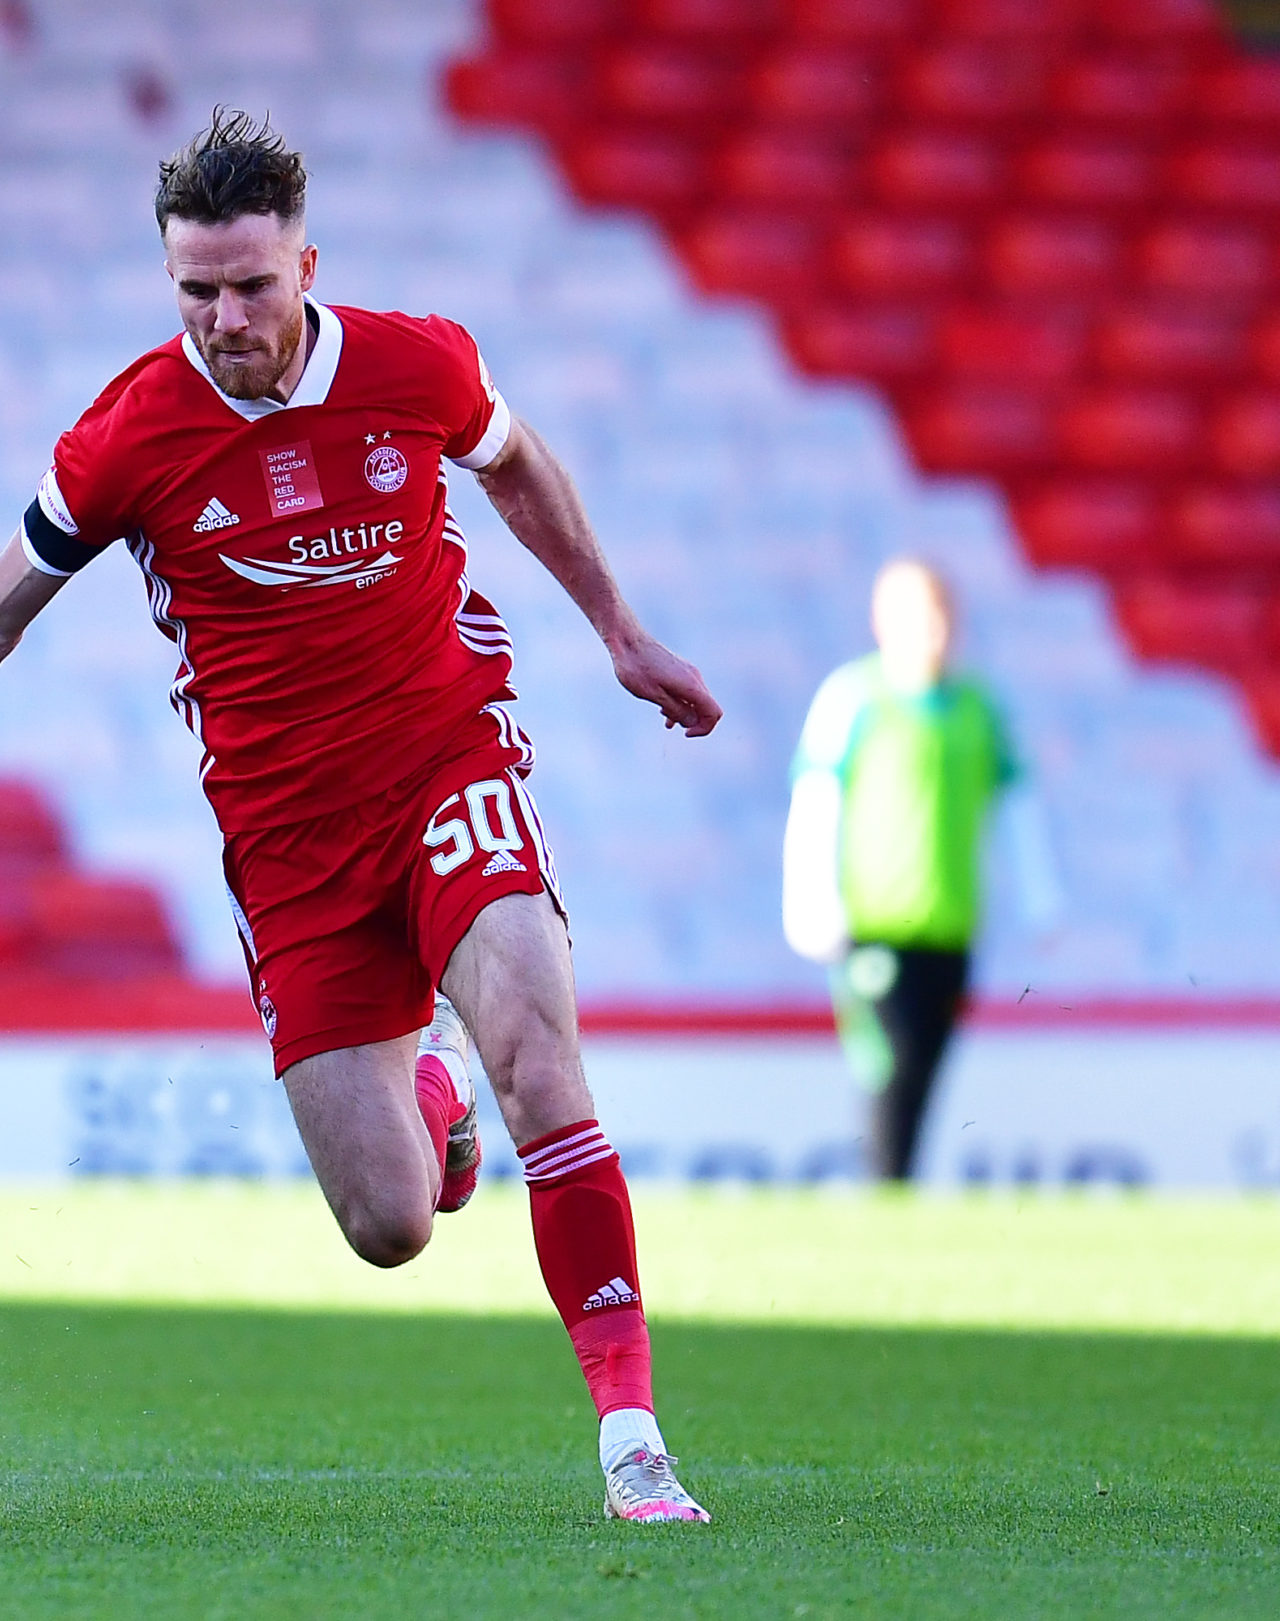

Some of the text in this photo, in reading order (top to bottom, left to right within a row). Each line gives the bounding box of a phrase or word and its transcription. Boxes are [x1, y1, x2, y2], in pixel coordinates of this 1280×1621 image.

[267, 449, 296, 463] SHOW
[269, 458, 307, 474] RACISM
[272, 473, 292, 485] THE
[274, 485, 295, 497] RED
[277, 496, 305, 510] CARD
[193, 513, 241, 533] adidas
[288, 520, 404, 564] Saltire
[422, 779, 524, 876] 50
[482, 862, 528, 877] adidas
[583, 1292, 639, 1311] adidas
